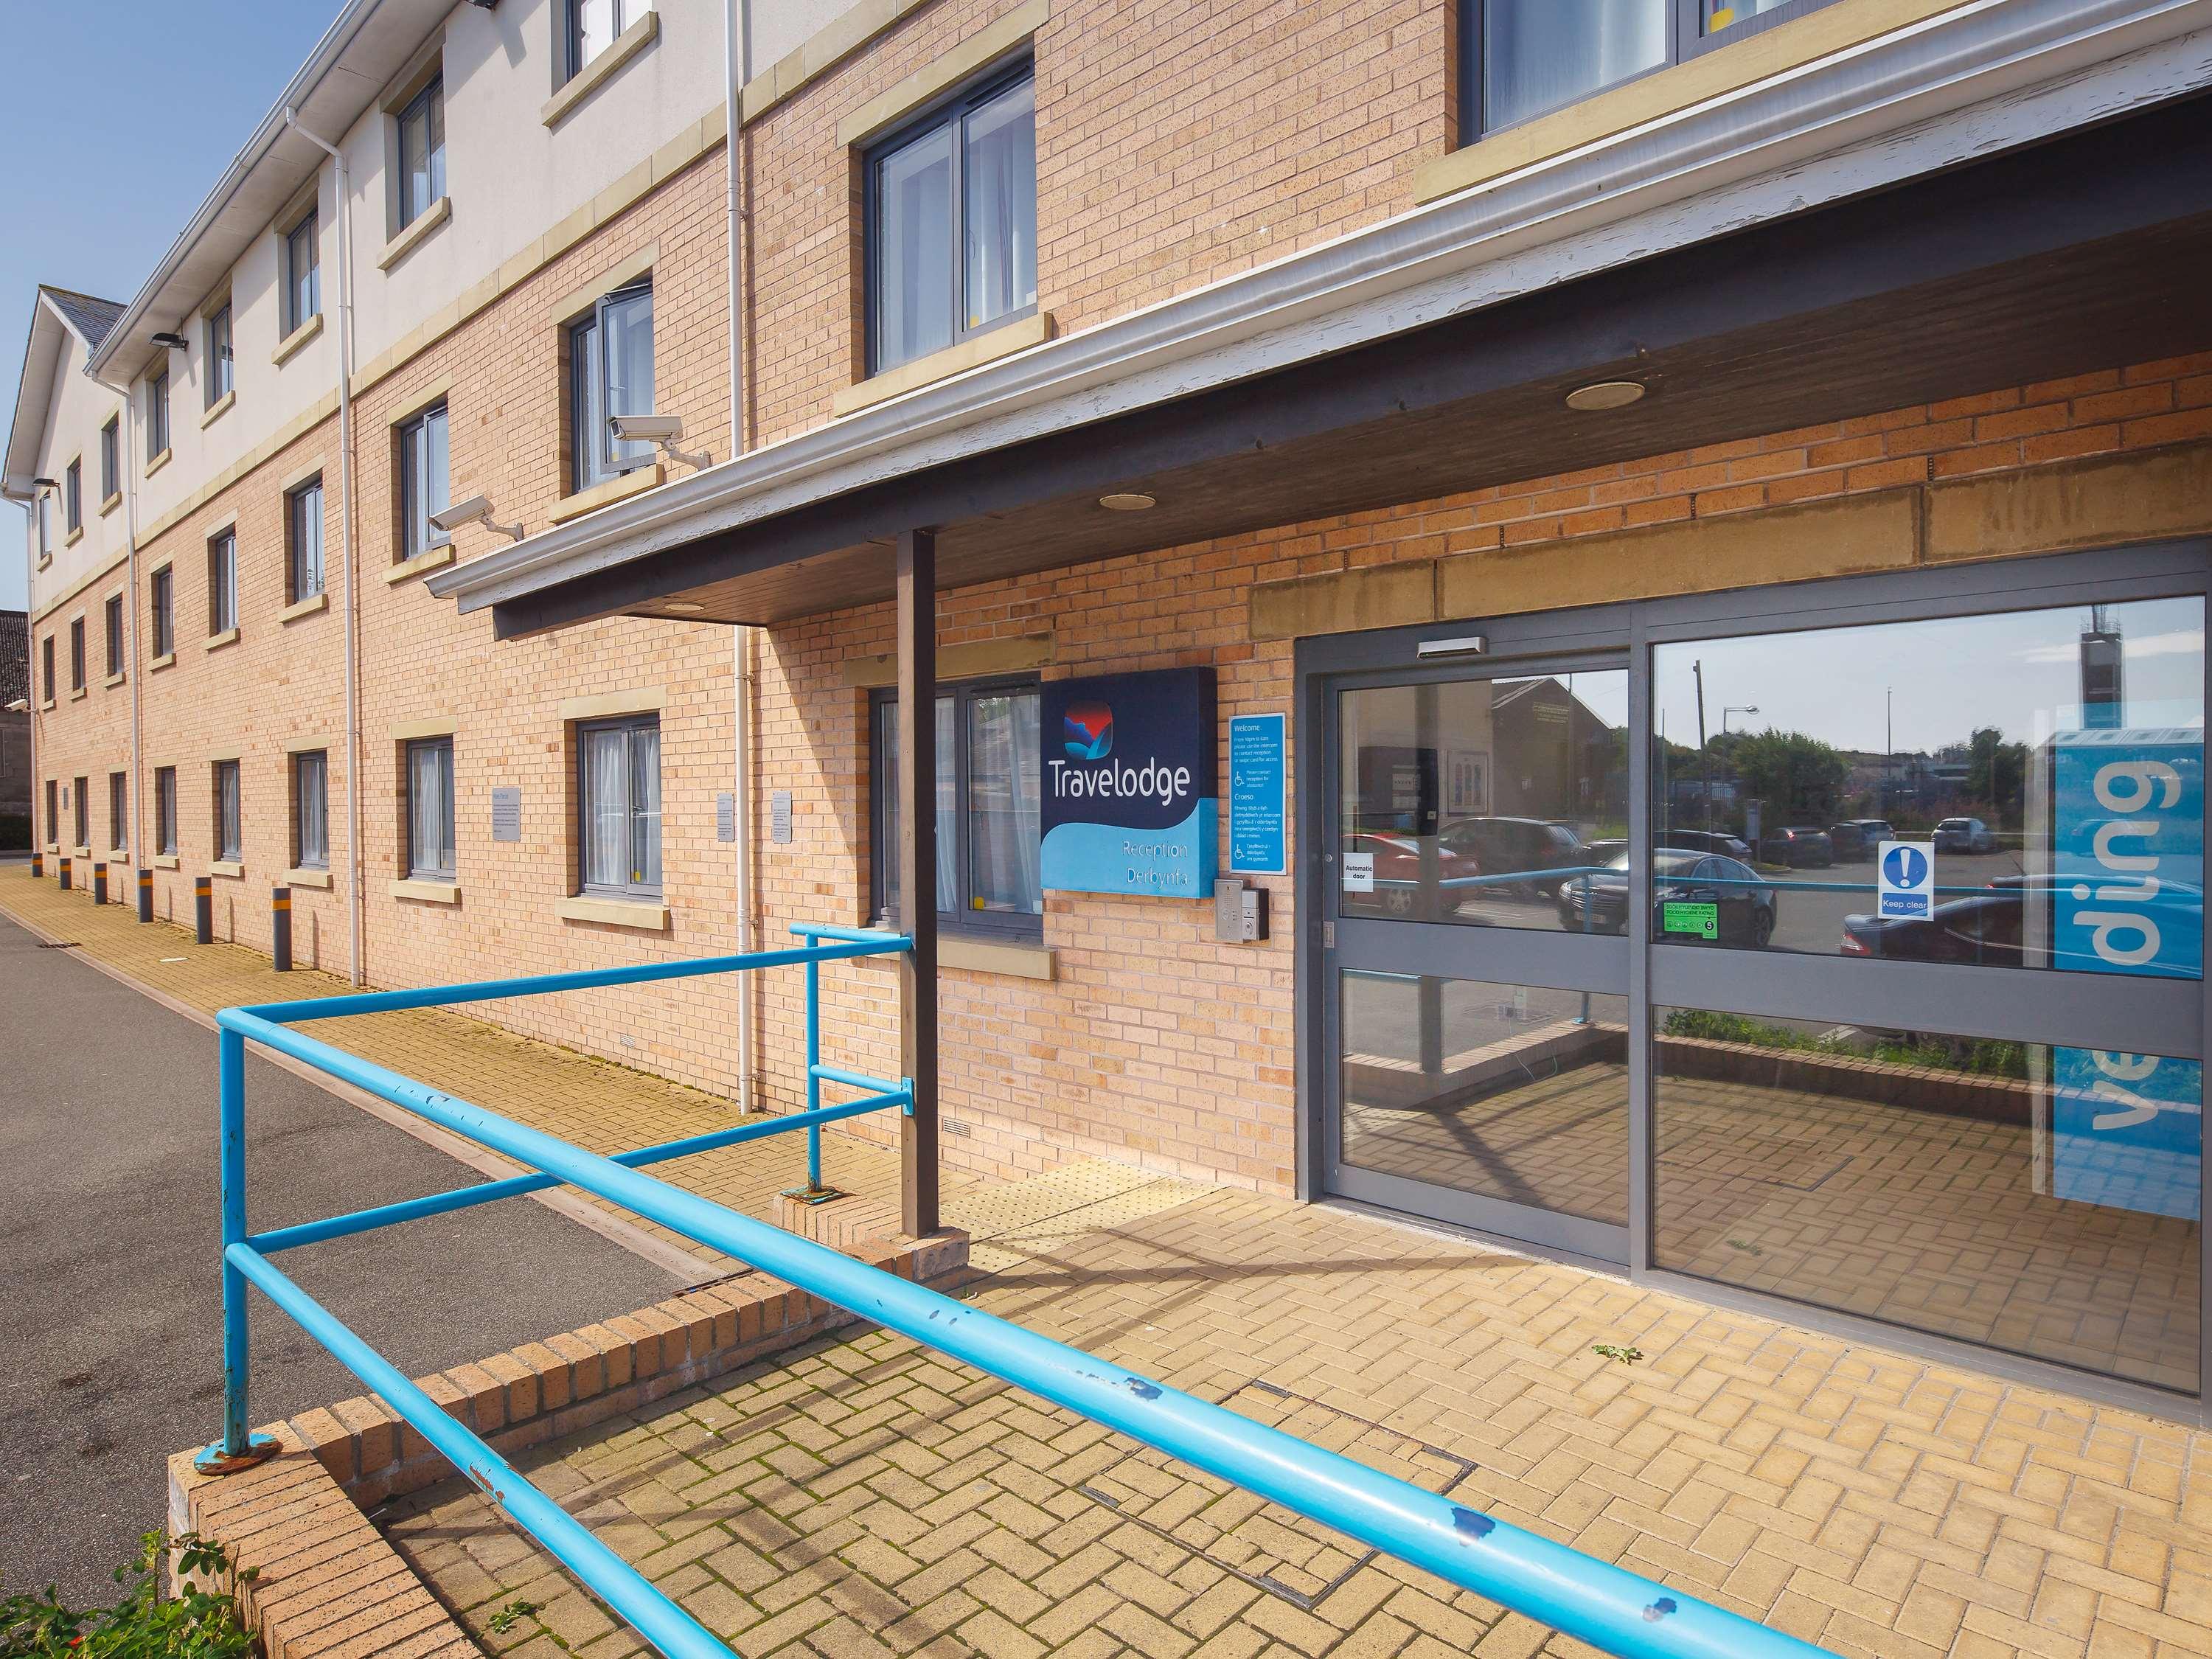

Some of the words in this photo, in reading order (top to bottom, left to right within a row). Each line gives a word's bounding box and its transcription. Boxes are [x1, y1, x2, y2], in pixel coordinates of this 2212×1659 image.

[1048, 757, 1190, 806] Travelodge
[1122, 841, 1187, 860] Reception
[1127, 868, 1187, 887] Derbynfa
[1883, 900, 1904, 908] Keep
[1907, 901, 1927, 909] clear
